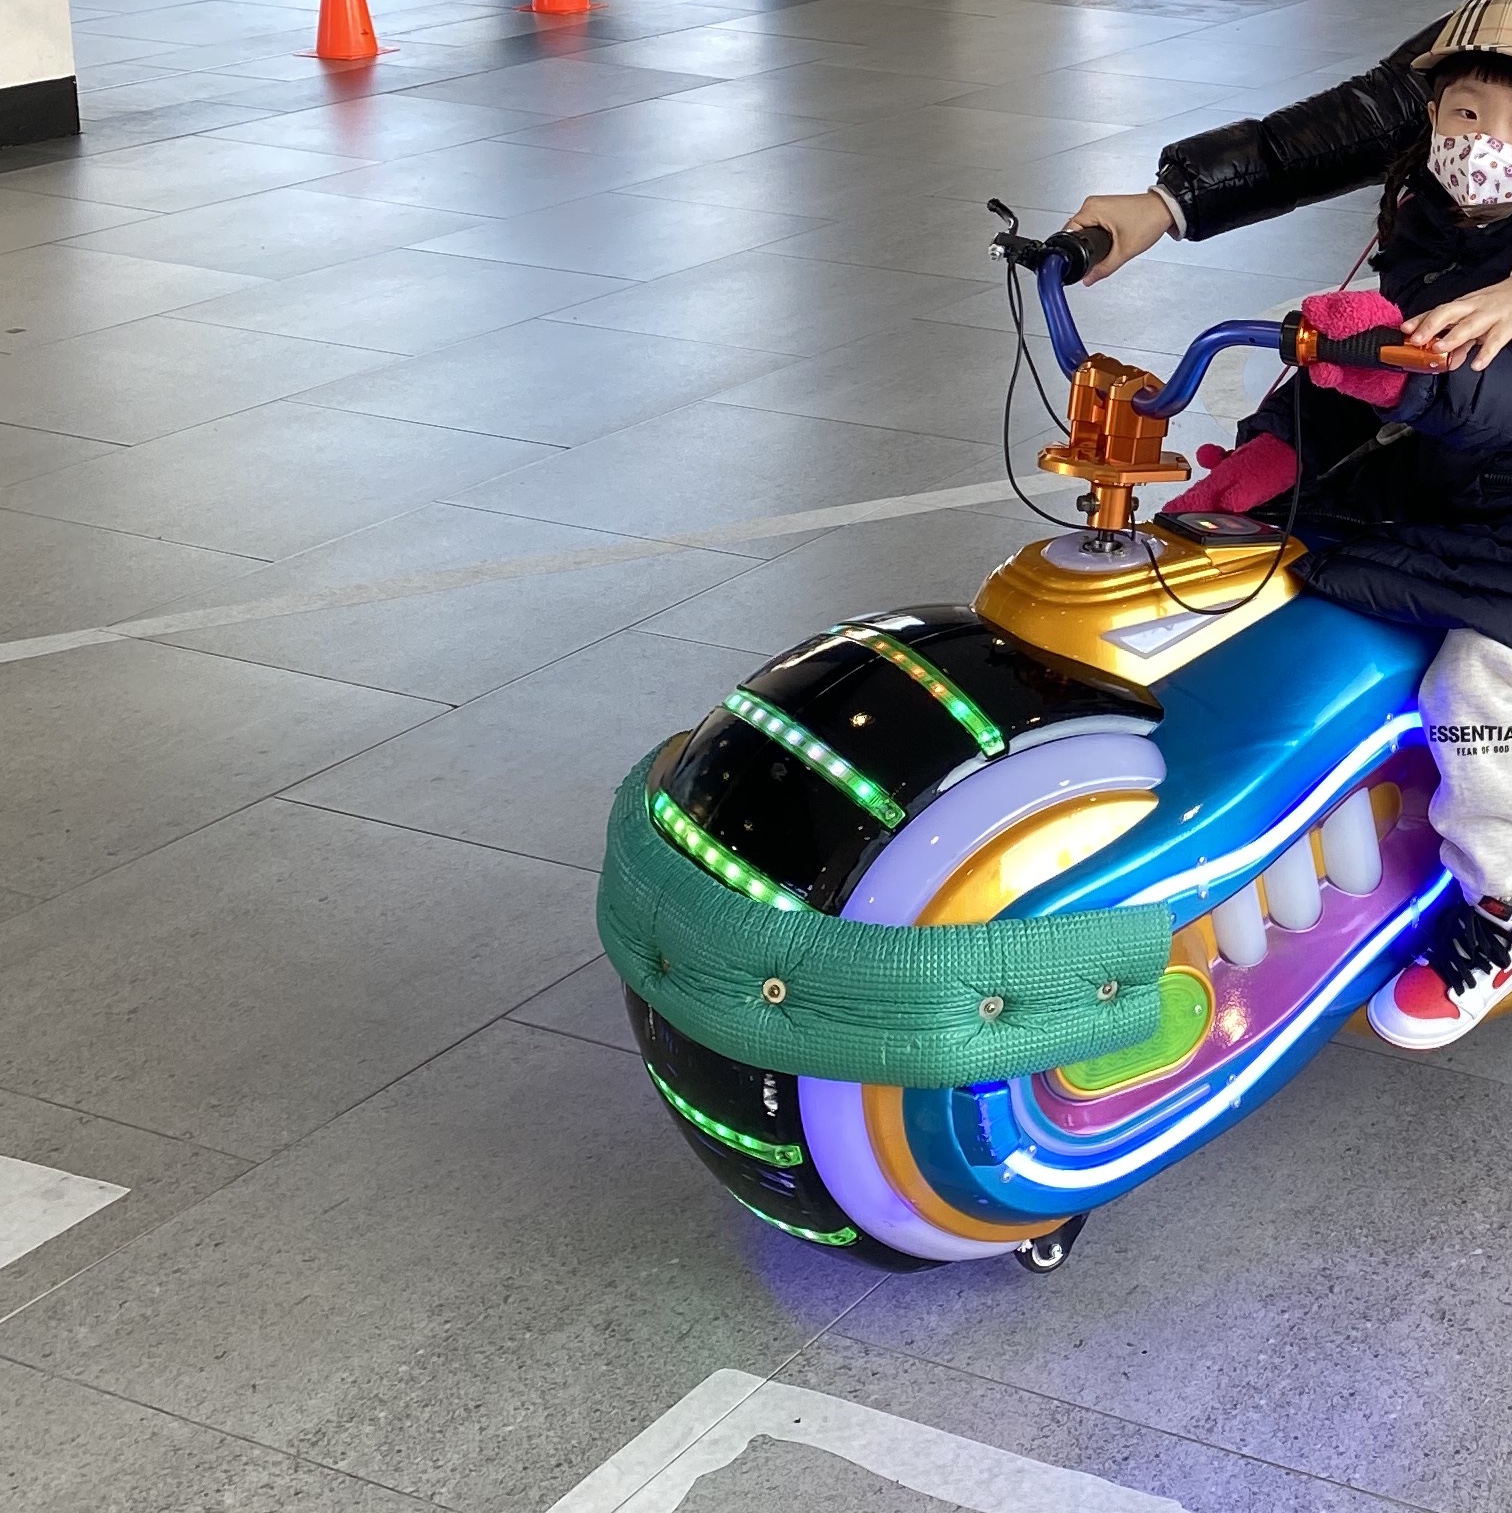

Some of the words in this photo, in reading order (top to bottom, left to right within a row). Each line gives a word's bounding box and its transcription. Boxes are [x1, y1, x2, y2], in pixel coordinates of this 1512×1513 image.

[1456, 747, 1478, 756] FEAR
[1481, 746, 1490, 754] OF
[1493, 745, 1510, 753] GOD
